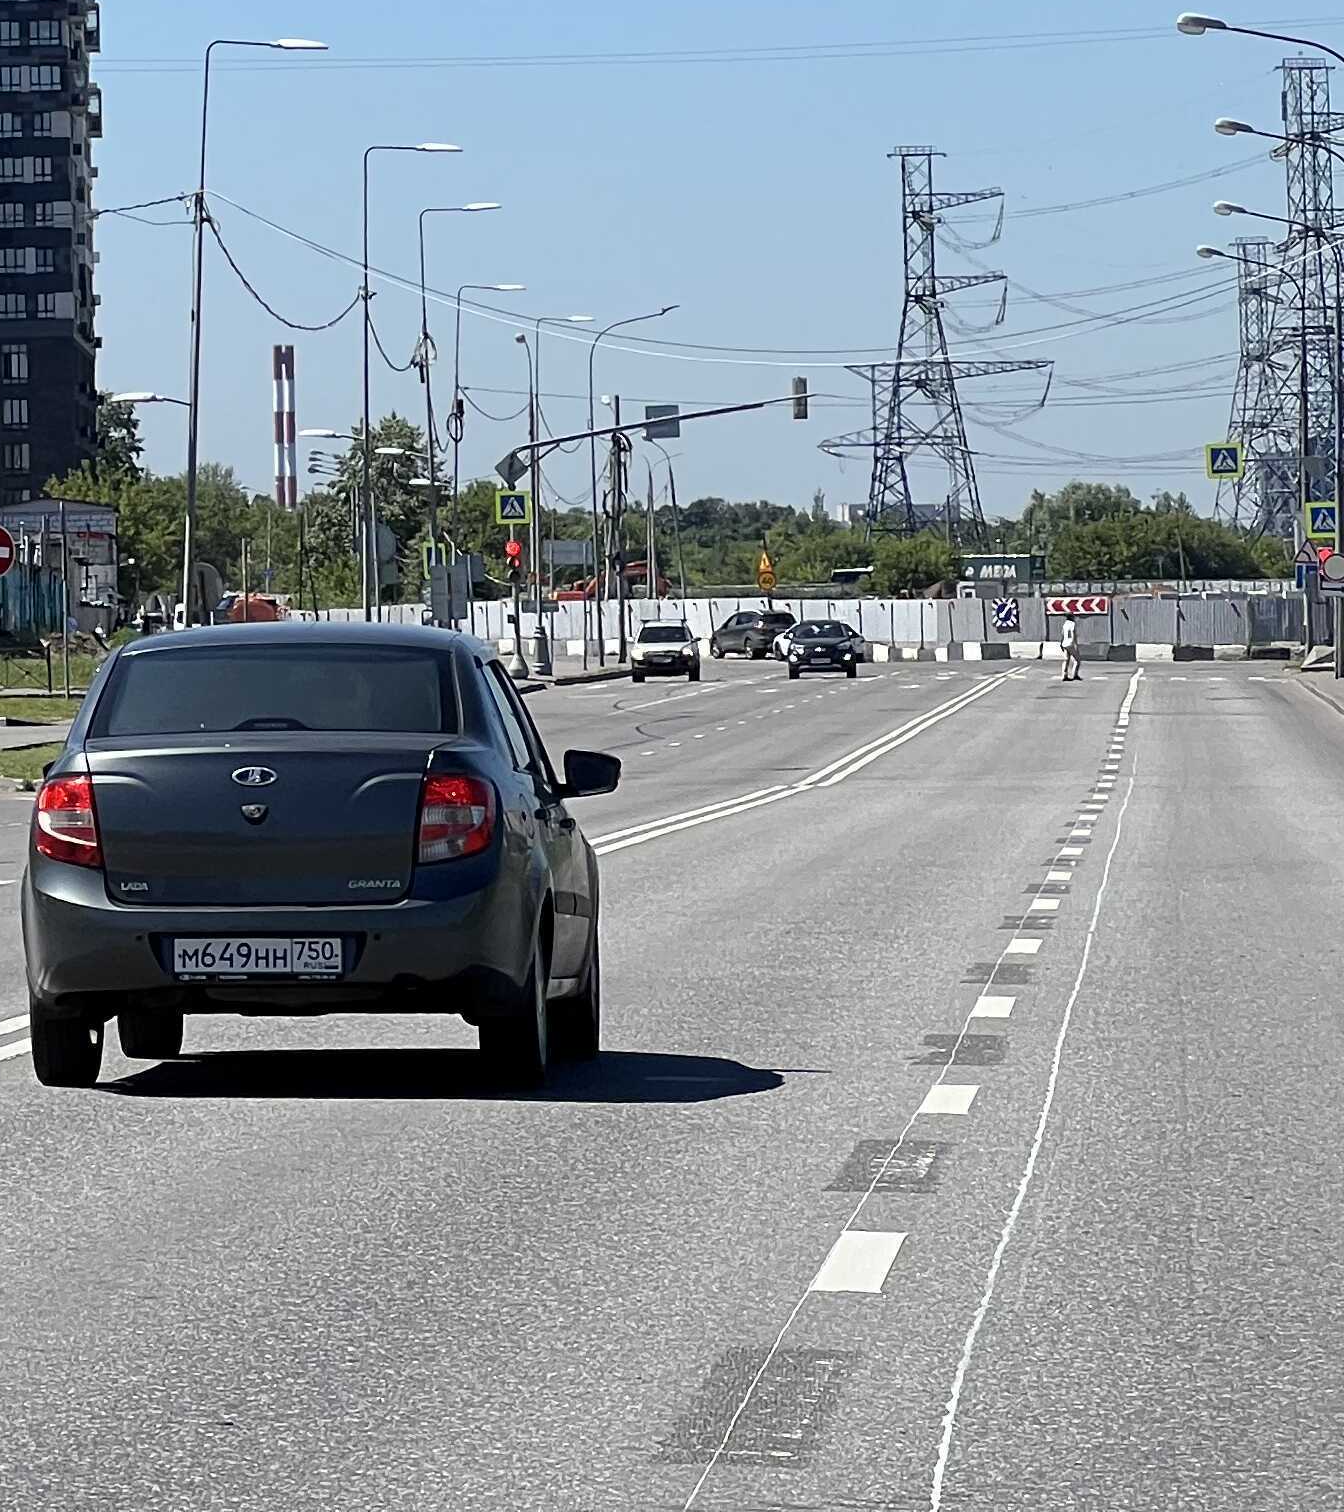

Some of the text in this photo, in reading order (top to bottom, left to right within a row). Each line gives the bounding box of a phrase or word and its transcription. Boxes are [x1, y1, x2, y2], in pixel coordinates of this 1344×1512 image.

[120, 882, 149, 891] LADA
[348, 879, 401, 889] GRANTA
[181, 941, 334, 969] М649НН 750
